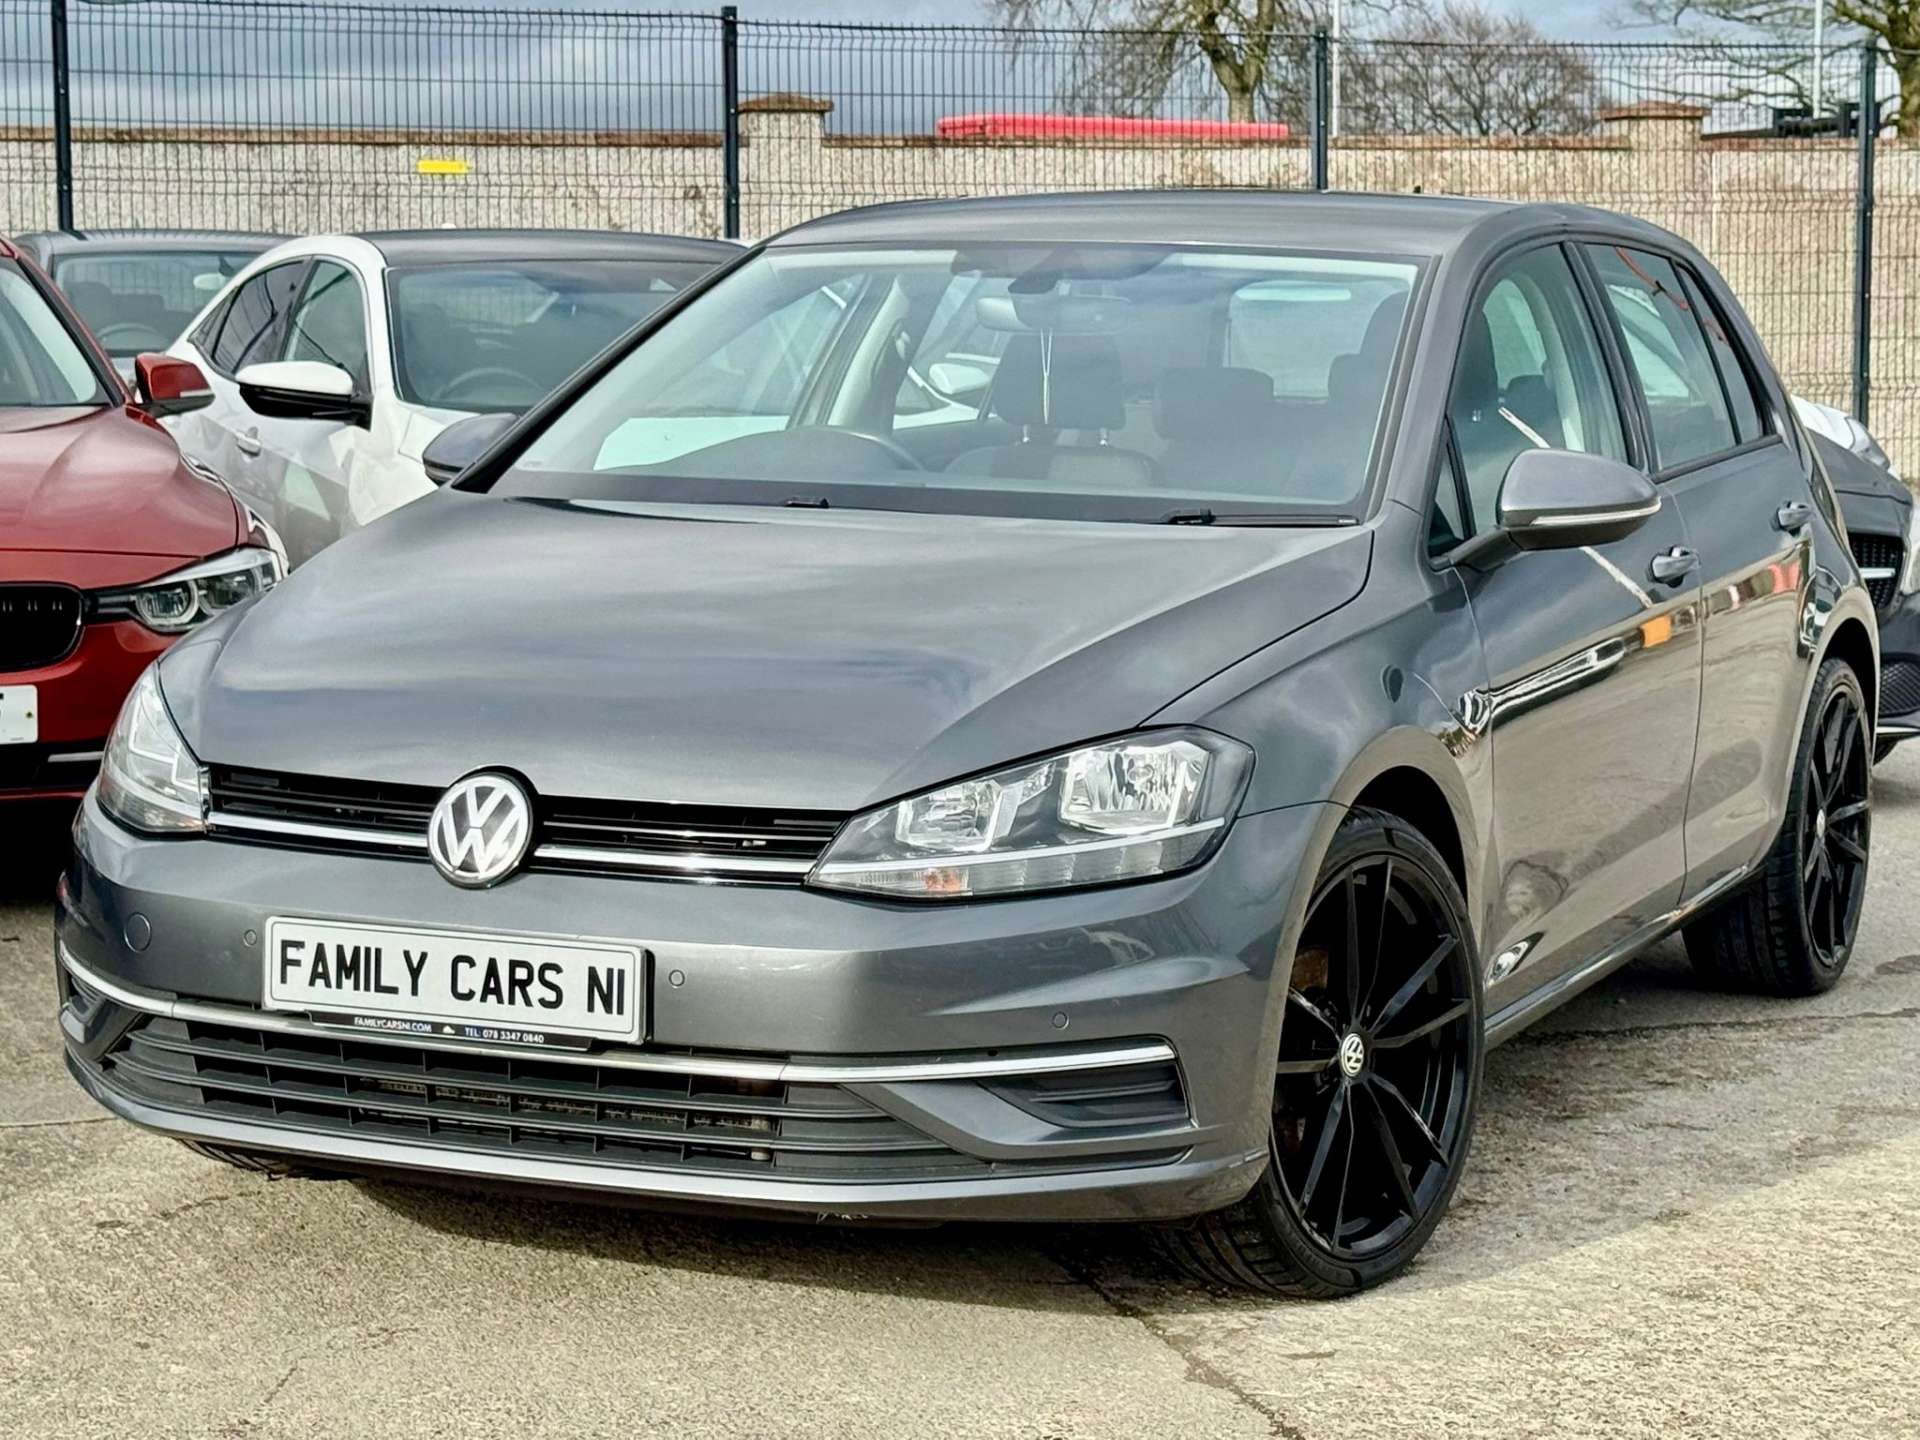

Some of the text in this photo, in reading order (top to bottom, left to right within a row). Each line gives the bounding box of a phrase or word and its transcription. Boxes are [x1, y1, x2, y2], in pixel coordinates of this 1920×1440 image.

[434, 779, 526, 878] VW
[280, 939, 428, 996] FAMILY
[450, 954, 564, 1010] CARS
[354, 1016, 432, 1033] FAMILYCARSNI.COM
[482, 1028, 499, 1040] 078
